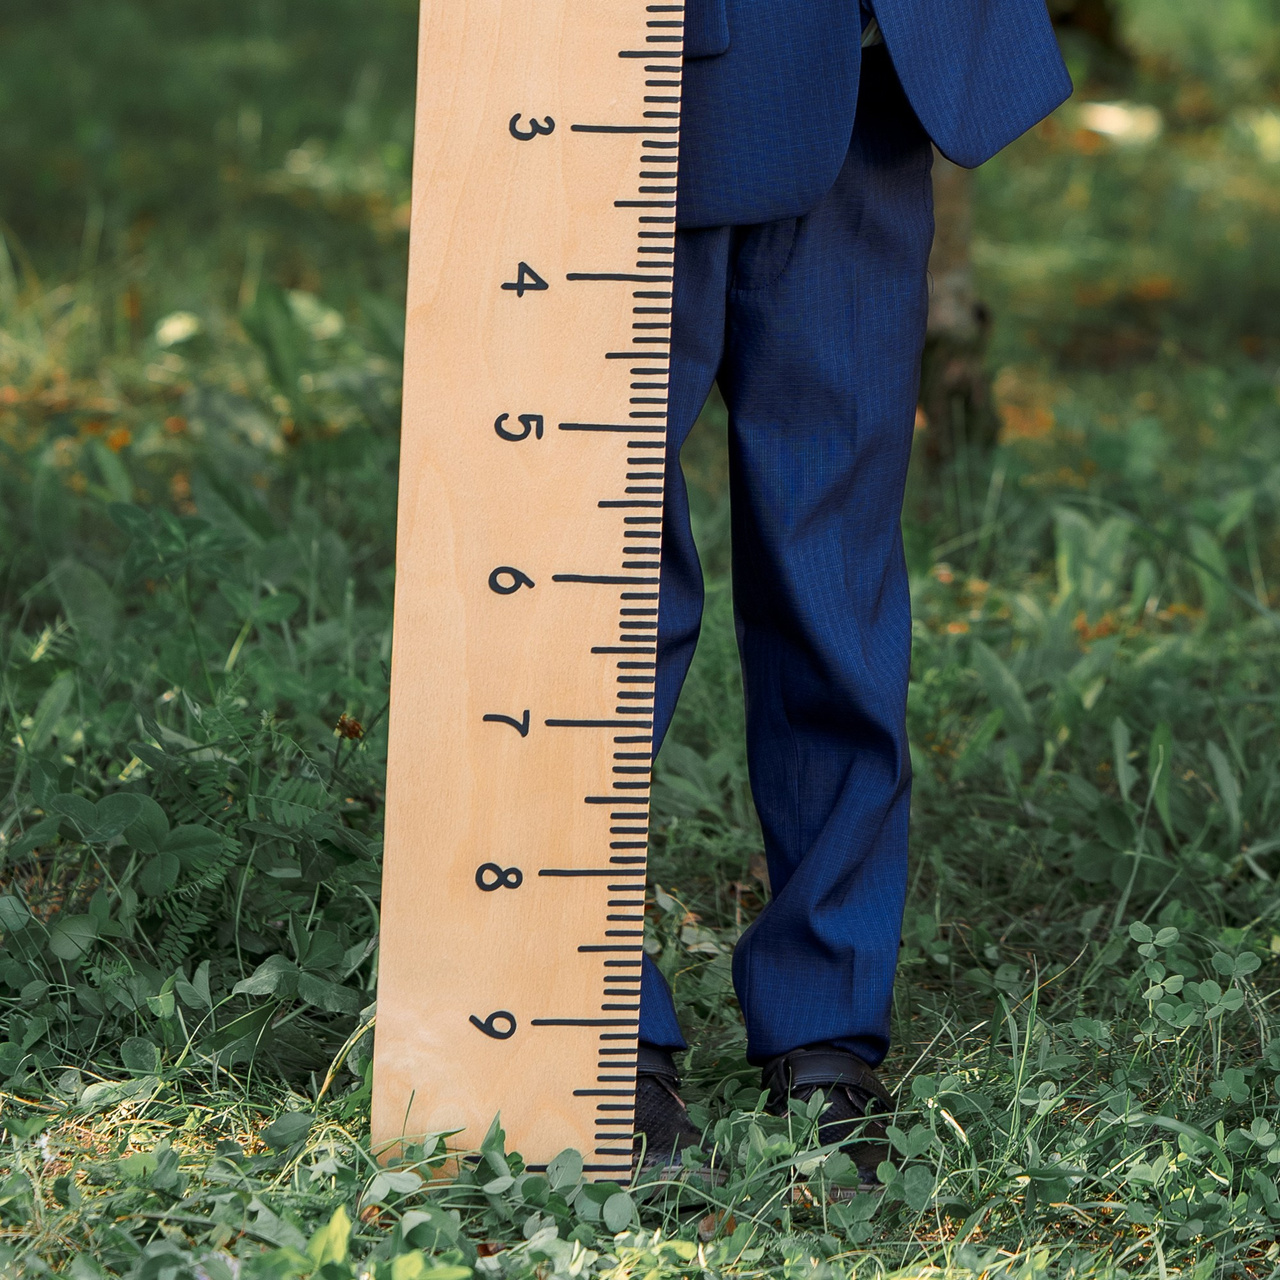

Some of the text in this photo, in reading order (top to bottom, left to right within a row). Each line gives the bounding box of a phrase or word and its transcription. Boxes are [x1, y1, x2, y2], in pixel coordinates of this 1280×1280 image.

[508, 112, 555, 142] 3
[500, 261, 549, 298] 4
[493, 412, 543, 442] 5
[487, 566, 535, 596] 6
[482, 709, 530, 738] 7
[474, 862, 523, 893] 8
[468, 1010, 517, 1041] 9
